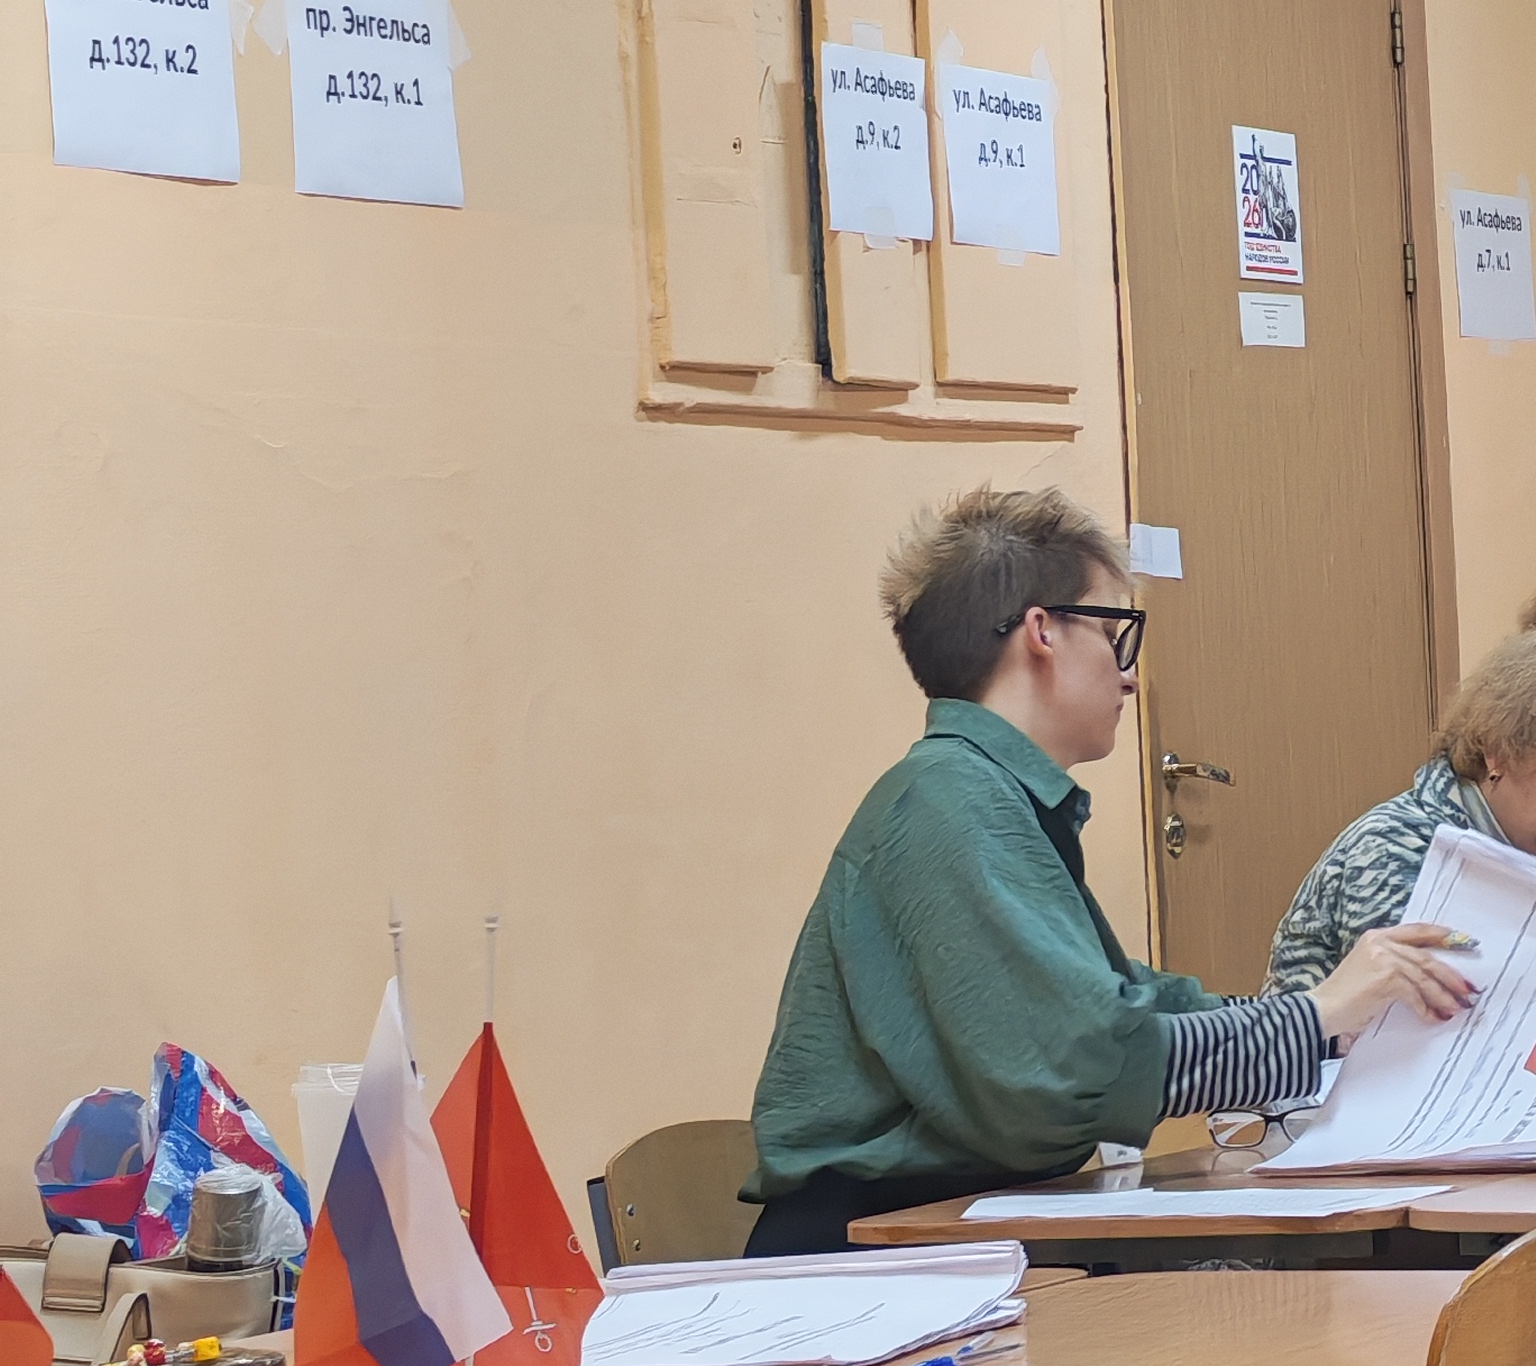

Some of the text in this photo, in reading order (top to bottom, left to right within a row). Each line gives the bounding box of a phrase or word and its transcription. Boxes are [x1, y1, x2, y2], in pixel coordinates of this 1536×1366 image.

[305, 5, 431, 46] пр. Энгельса
[89, 36, 199, 75] д.132, к.2
[325, 71, 424, 107] д.132, к.1
[830, 67, 916, 102] ул. Асафьева
[952, 87, 1043, 122] ул. Асафьева
[855, 121, 902, 151] д.9, к.2
[978, 139, 1026, 169] д.9, к.1
[1240, 162, 1260, 196] 20
[1242, 196, 1262, 229] 26
[1459, 206, 1522, 233] ул. Асафьева
[1476, 248, 1511, 272] д.7, к.1
